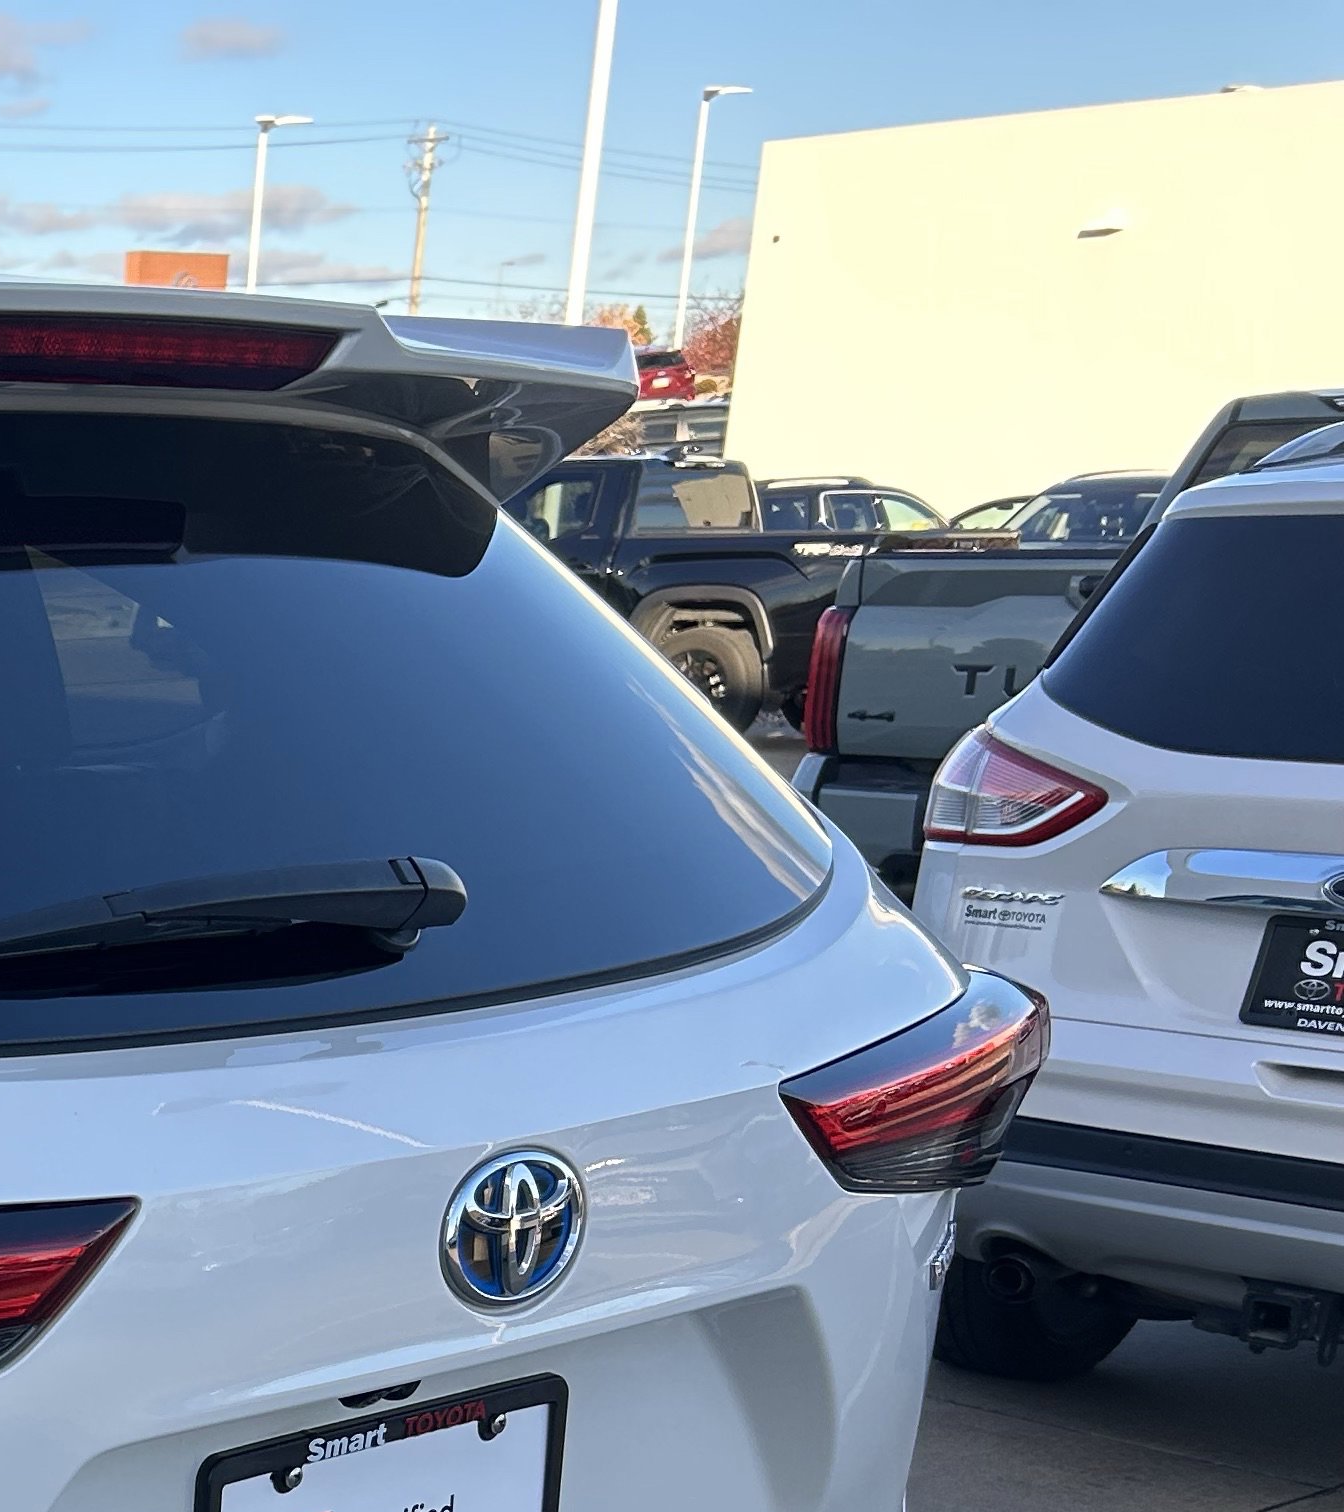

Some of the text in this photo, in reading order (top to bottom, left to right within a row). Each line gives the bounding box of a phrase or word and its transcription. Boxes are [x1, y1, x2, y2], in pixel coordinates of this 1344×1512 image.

[965, 904, 1046, 924] Smart TOYOTA
[307, 1400, 486, 1462] Smart TOYOTA
